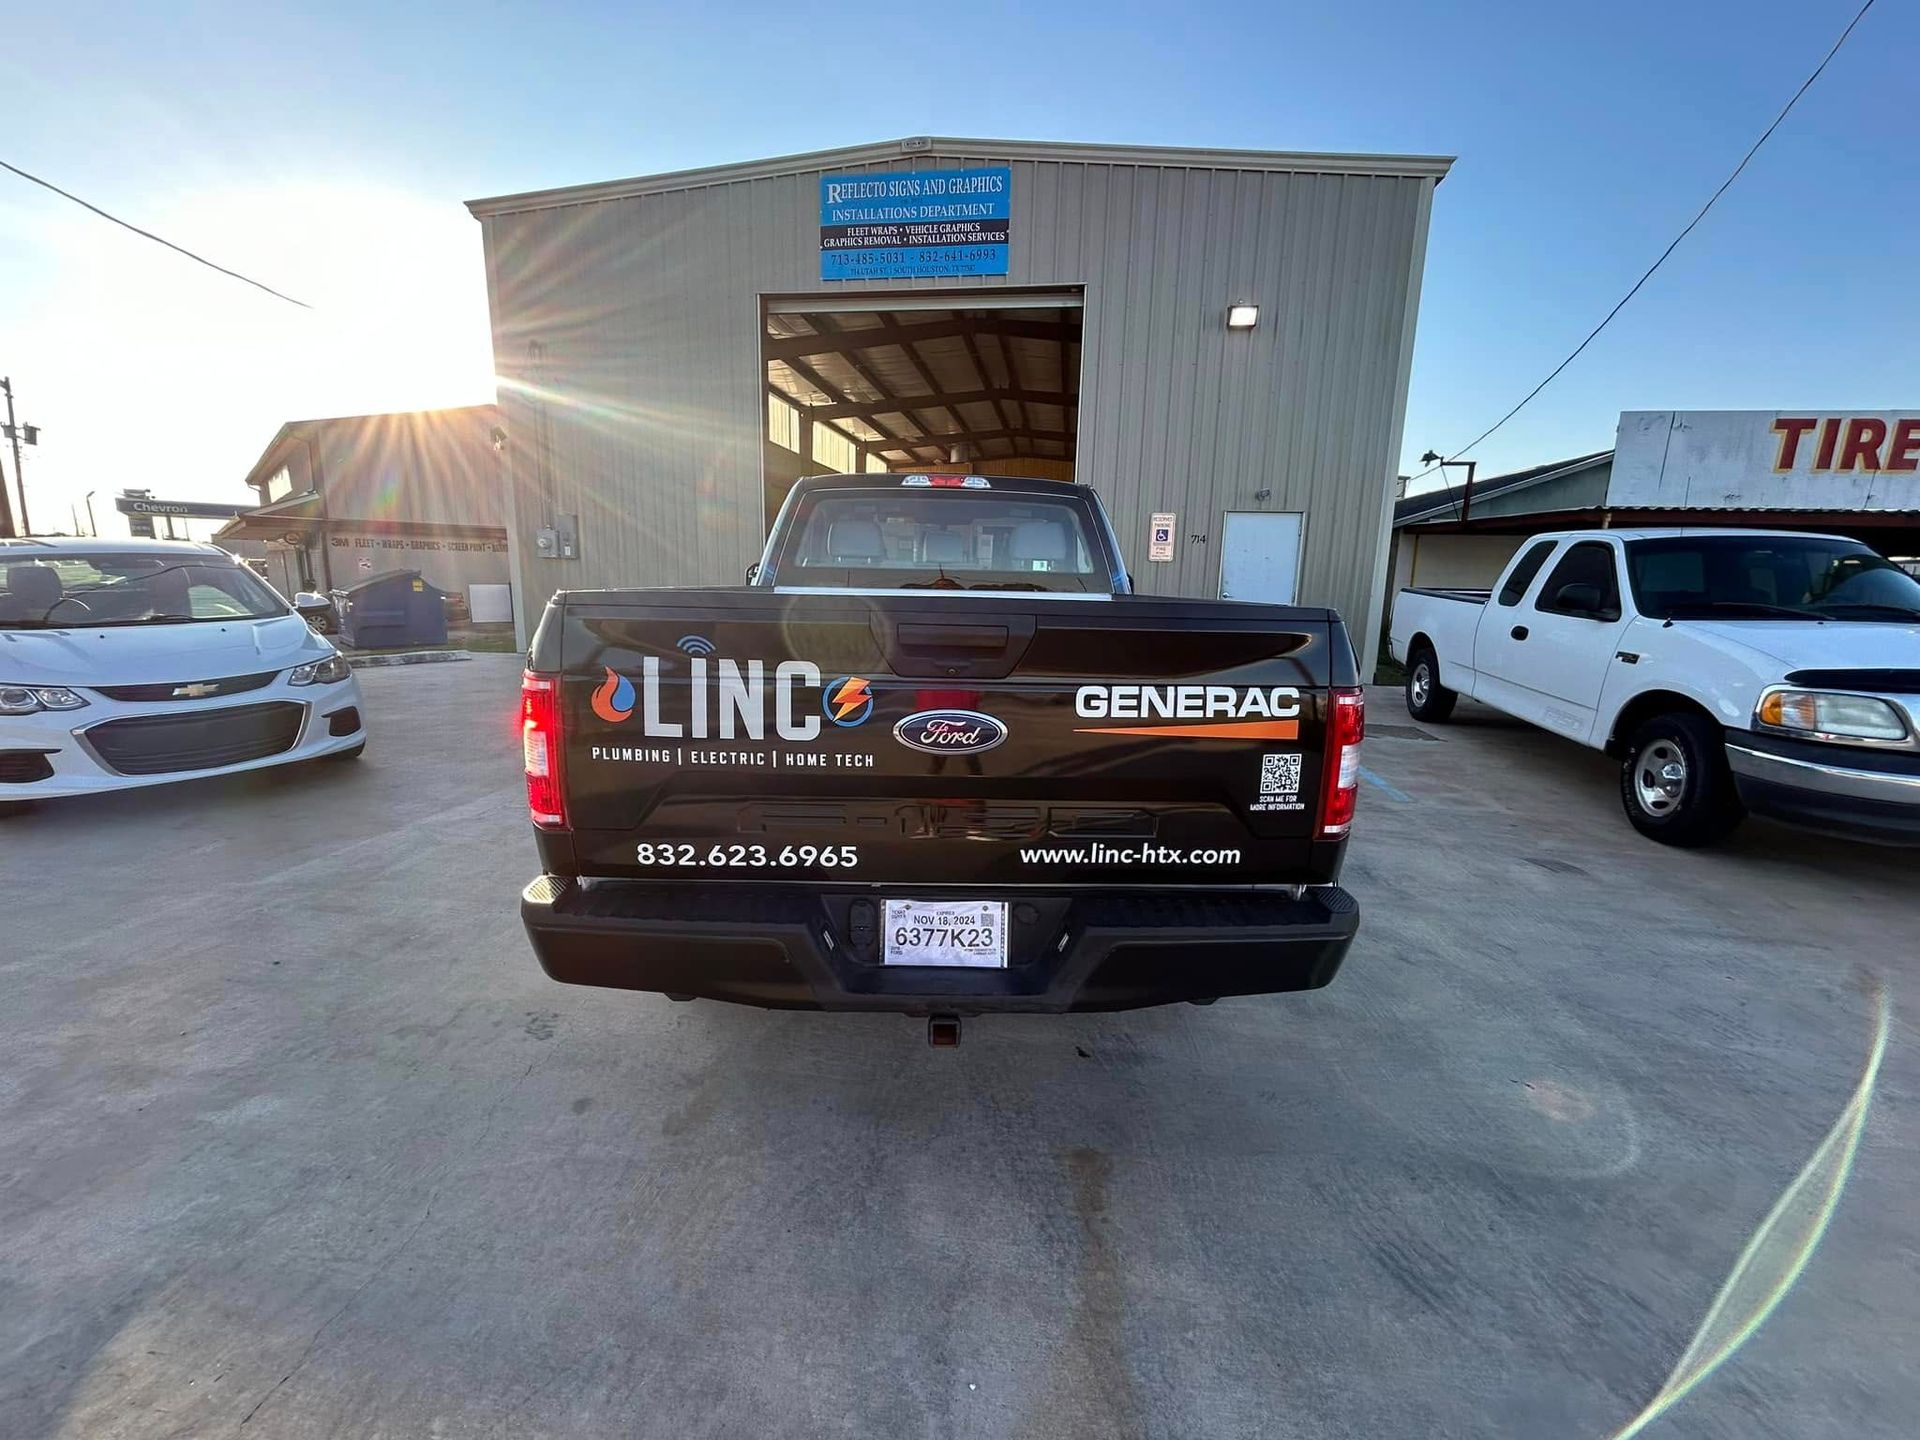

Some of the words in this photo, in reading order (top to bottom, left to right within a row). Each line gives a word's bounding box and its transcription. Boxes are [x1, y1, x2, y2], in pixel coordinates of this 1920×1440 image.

[827, 182, 886, 204] REFLECTO
[889, 179, 920, 197] SIGNS
[922, 178, 946, 196] AND
[948, 175, 1003, 195] GRAPHICS
[832, 207, 917, 221] INSTALLATIONS
[920, 202, 995, 218] DEPARTMENT
[823, 236, 863, 248] GRAPHICS
[863, 234, 902, 246] REMOVAL
[909, 233, 967, 244] INSTALLATION
[967, 231, 1006, 242] SERVICES
[847, 227, 869, 237] FLEET
[870, 225, 898, 236] WRAPS
[905, 224, 938, 235] VEHICLE
[939, 222, 981, 233] GRAPHICS
[831, 251, 906, 266] 713-485-5031
[919, 248, 997, 263] 832-641-6993
[133, 502, 189, 514] Chevron
[1191, 534, 1206, 544] 714
[643, 656, 822, 741] LINC
[1076, 686, 1300, 718] GENERAC
[920, 719, 981, 745] Ford
[592, 747, 670, 763] PLUMBING
[691, 750, 765, 766] ELECTRIC
[786, 753, 827, 767] HOME
[835, 754, 874, 768] TECH
[636, 843, 858, 868] 832.623.6965
[1020, 843, 1241, 864] www.linc-htx.com
[913, 915, 935, 925] NOV
[938, 916, 951, 926] 18,
[953, 916, 975, 925] 2024
[895, 927, 993, 948] 6377K23
